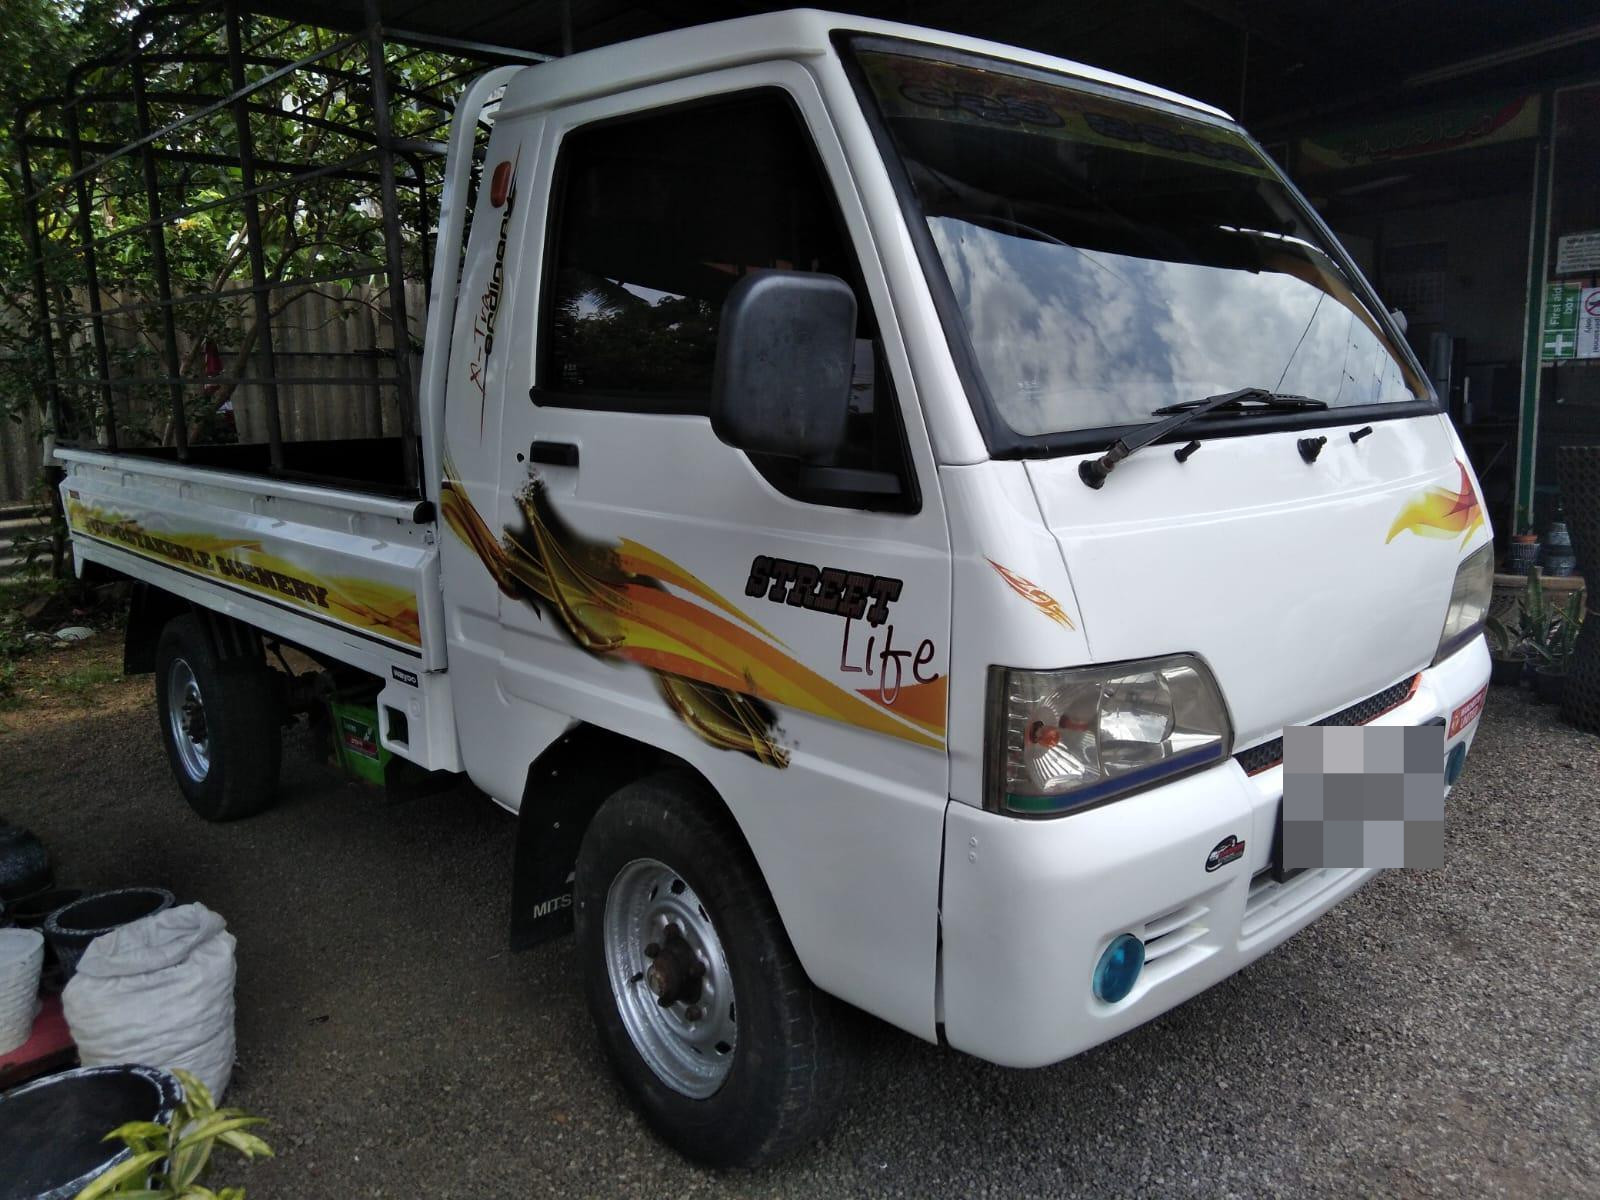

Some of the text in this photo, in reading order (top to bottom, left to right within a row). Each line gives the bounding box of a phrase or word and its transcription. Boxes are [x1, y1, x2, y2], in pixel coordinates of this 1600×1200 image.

[1551, 287, 1562, 325] First aid
[1564, 296, 1574, 315] box
[745, 555, 904, 625] STREET
[840, 616, 939, 705] Life
